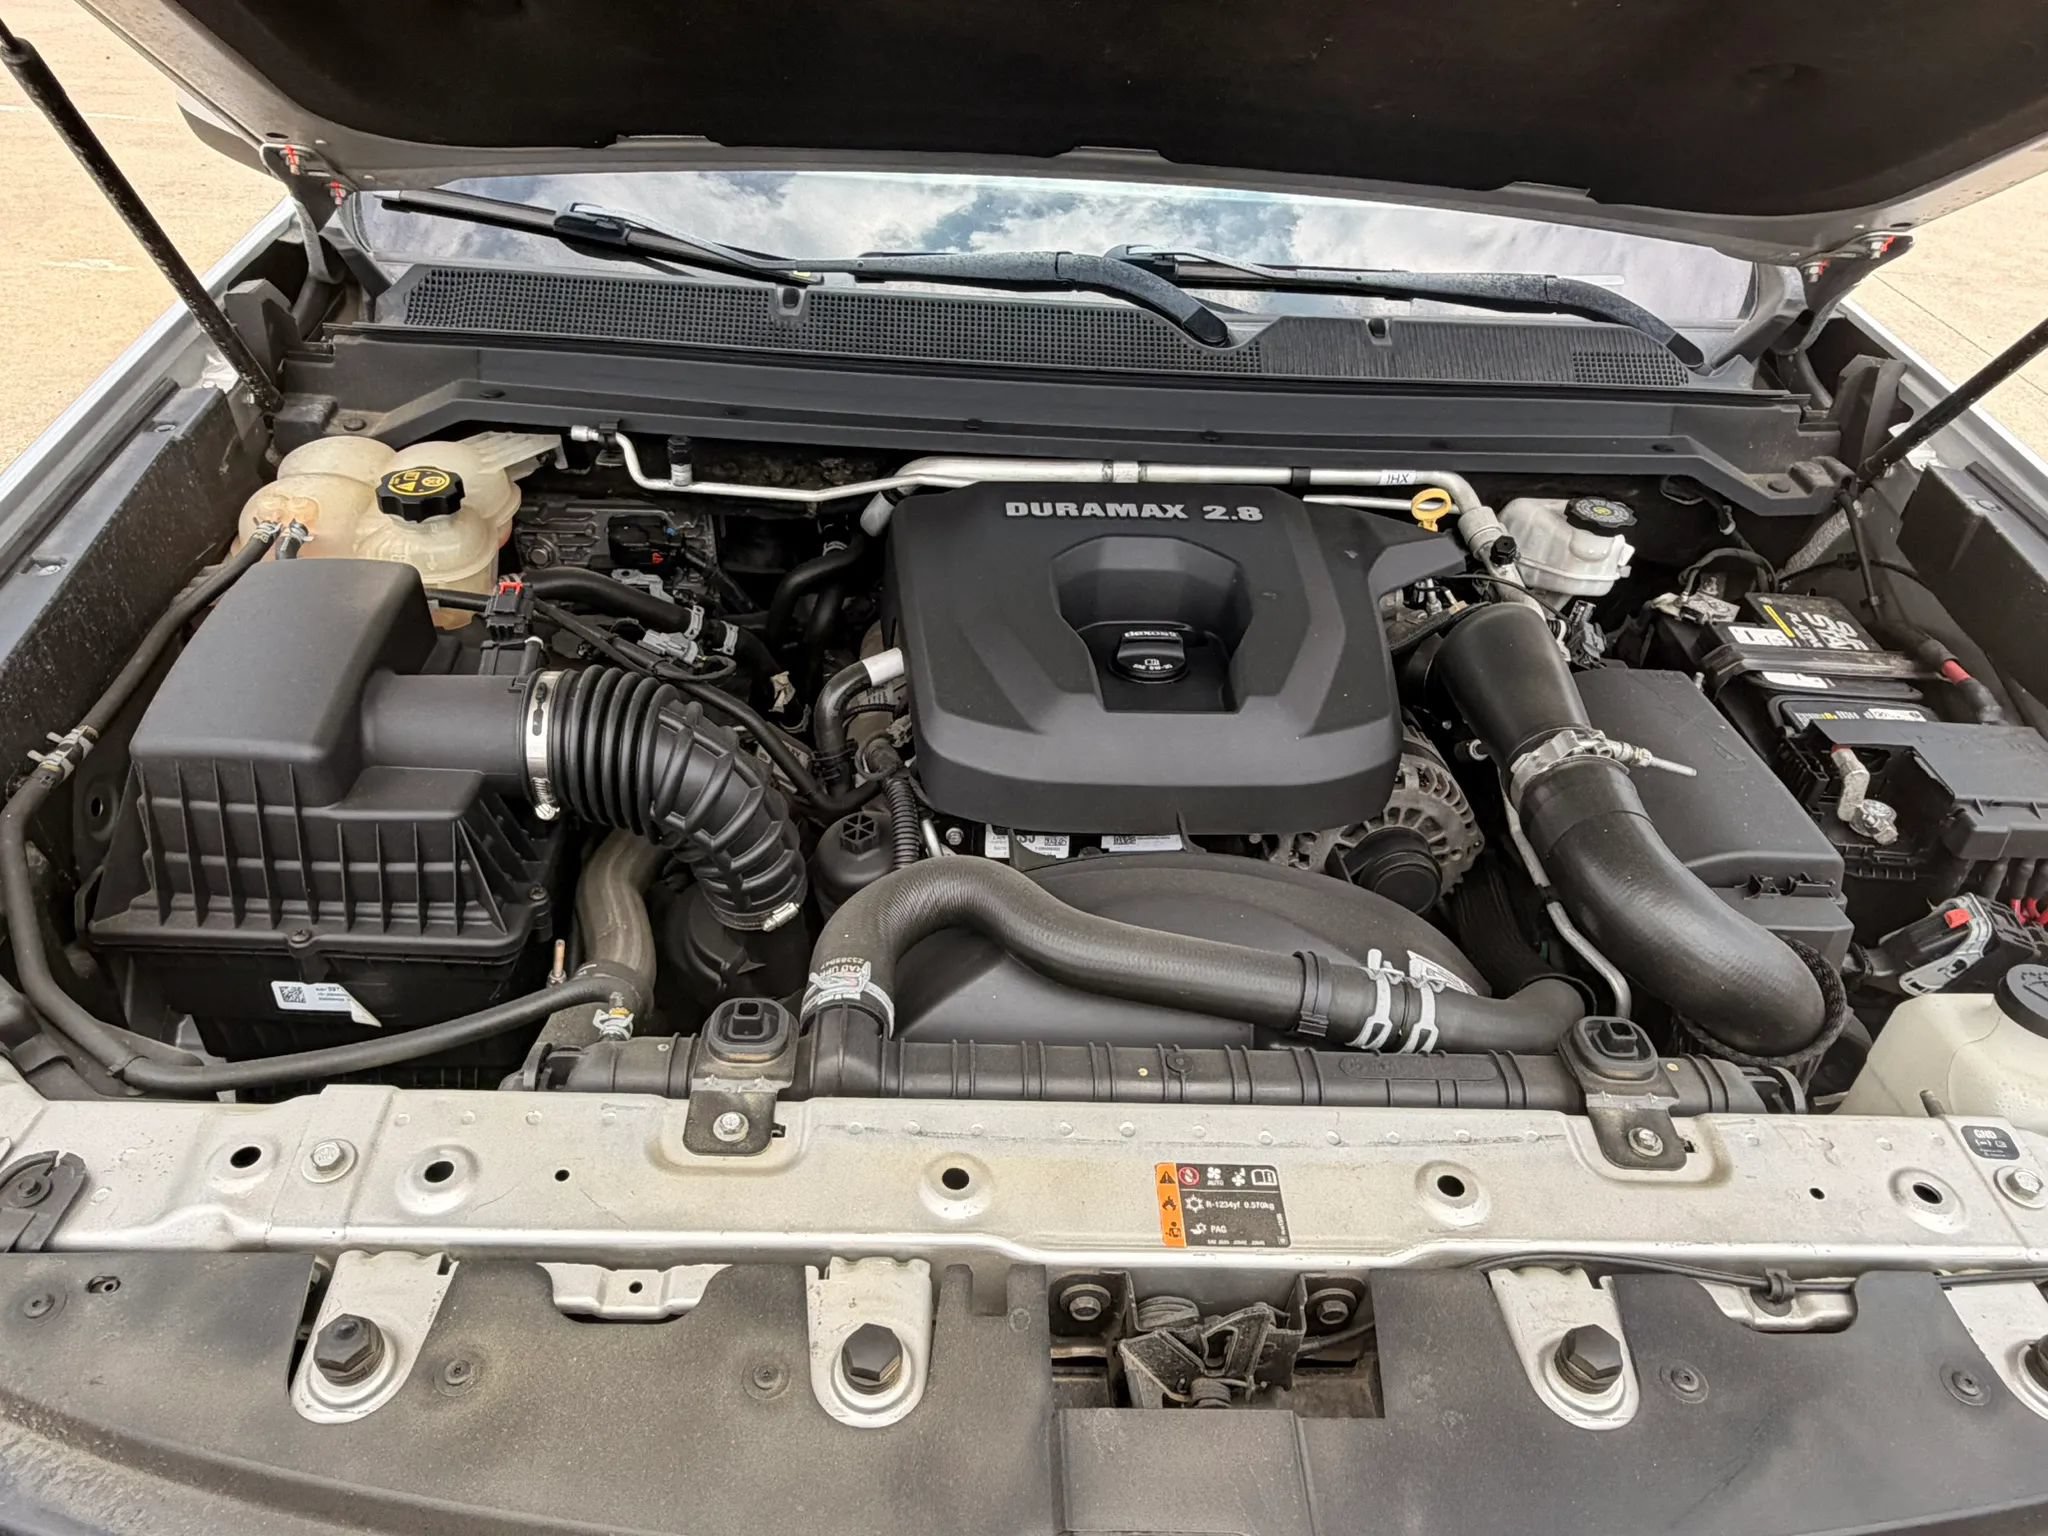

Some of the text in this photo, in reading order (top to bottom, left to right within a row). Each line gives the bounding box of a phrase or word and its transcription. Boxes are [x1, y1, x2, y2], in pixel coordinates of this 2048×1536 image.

[1005, 501, 1264, 522] DURAMAX 2.8
[1206, 1200, 1241, 1210] R-1234yf
[1210, 1225, 1228, 1234] PAG
